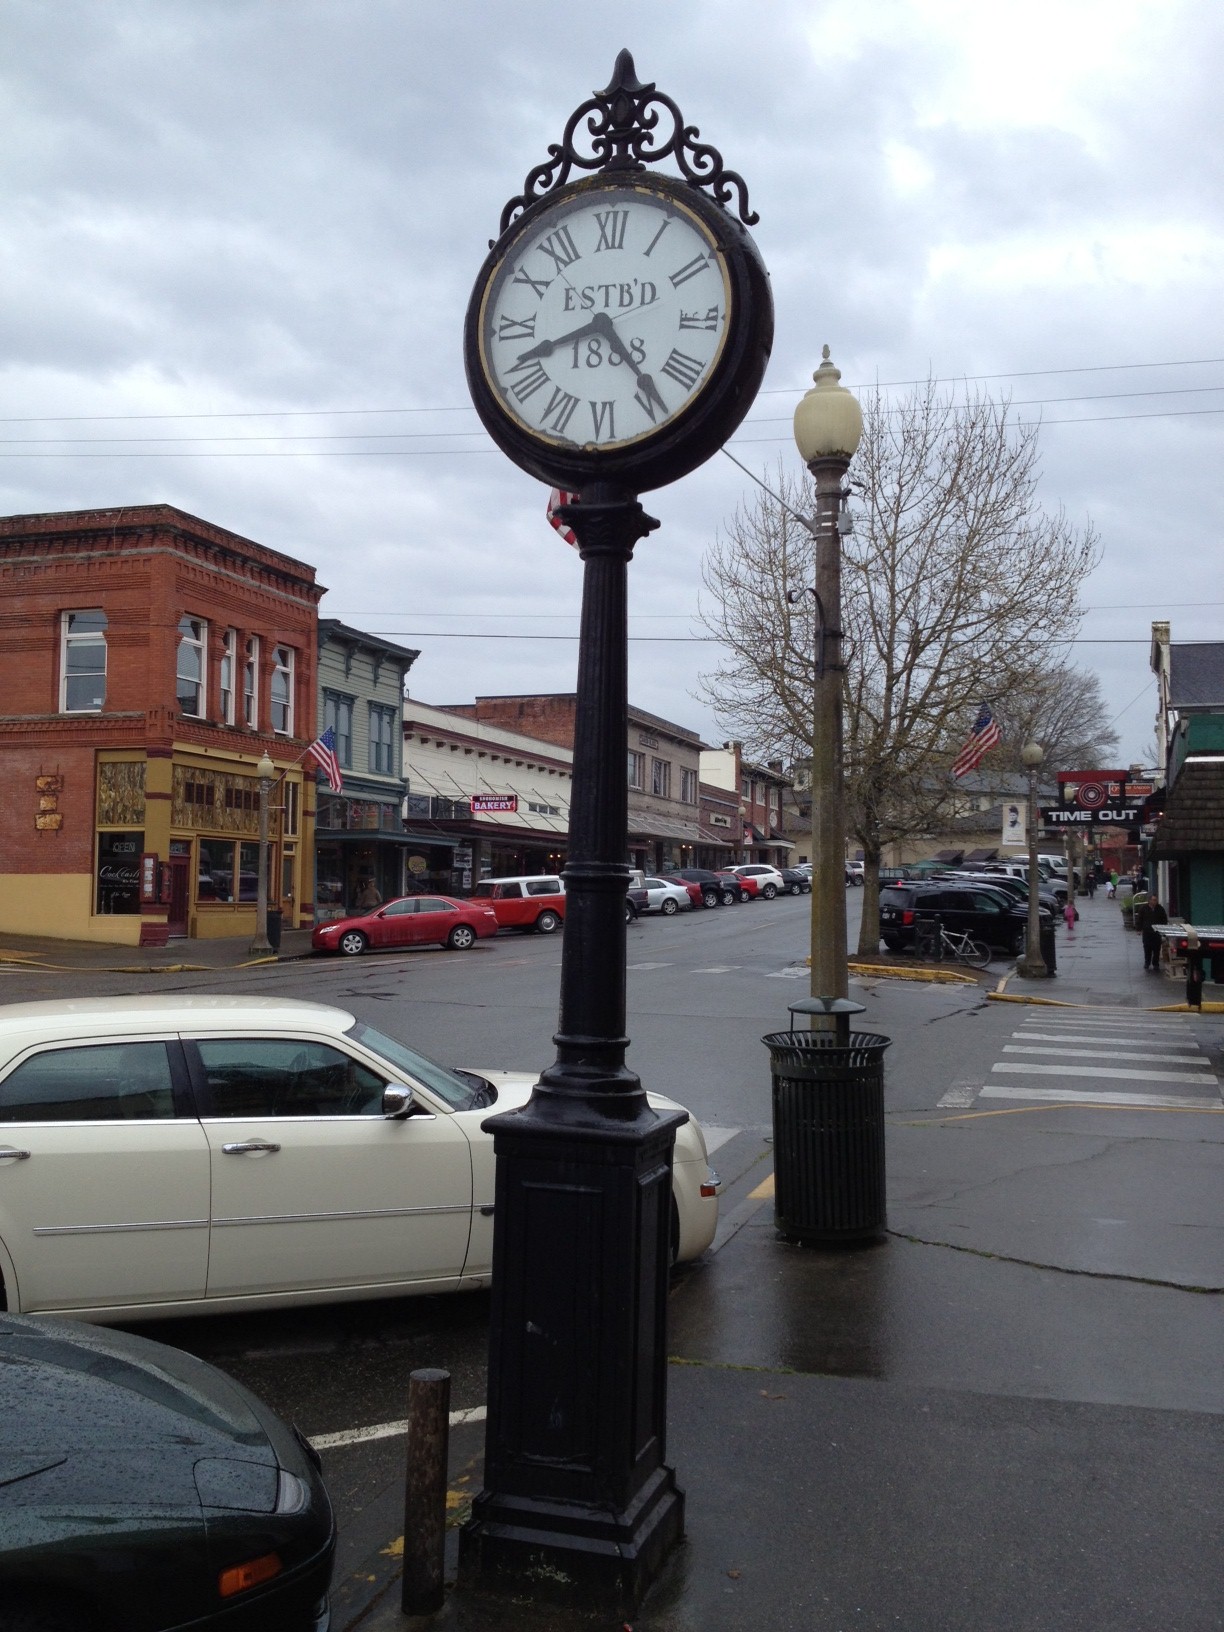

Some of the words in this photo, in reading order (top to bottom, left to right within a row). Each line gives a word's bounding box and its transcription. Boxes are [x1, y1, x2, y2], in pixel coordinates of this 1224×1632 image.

[593, 210, 629, 253] XII
[512, 265, 555, 301] X
[669, 253, 710, 290] II
[563, 279, 660, 312] ESTB'D
[499, 311, 537, 342] IX
[661, 348, 706, 391] IIII
[539, 385, 581, 434] VII
[588, 400, 616, 441] VI
[474, 801, 512, 810] BAKERY
[1048, 811, 1092, 822] TIME
[1098, 810, 1137, 821] OUT
[113, 842, 135, 852] OPEN
